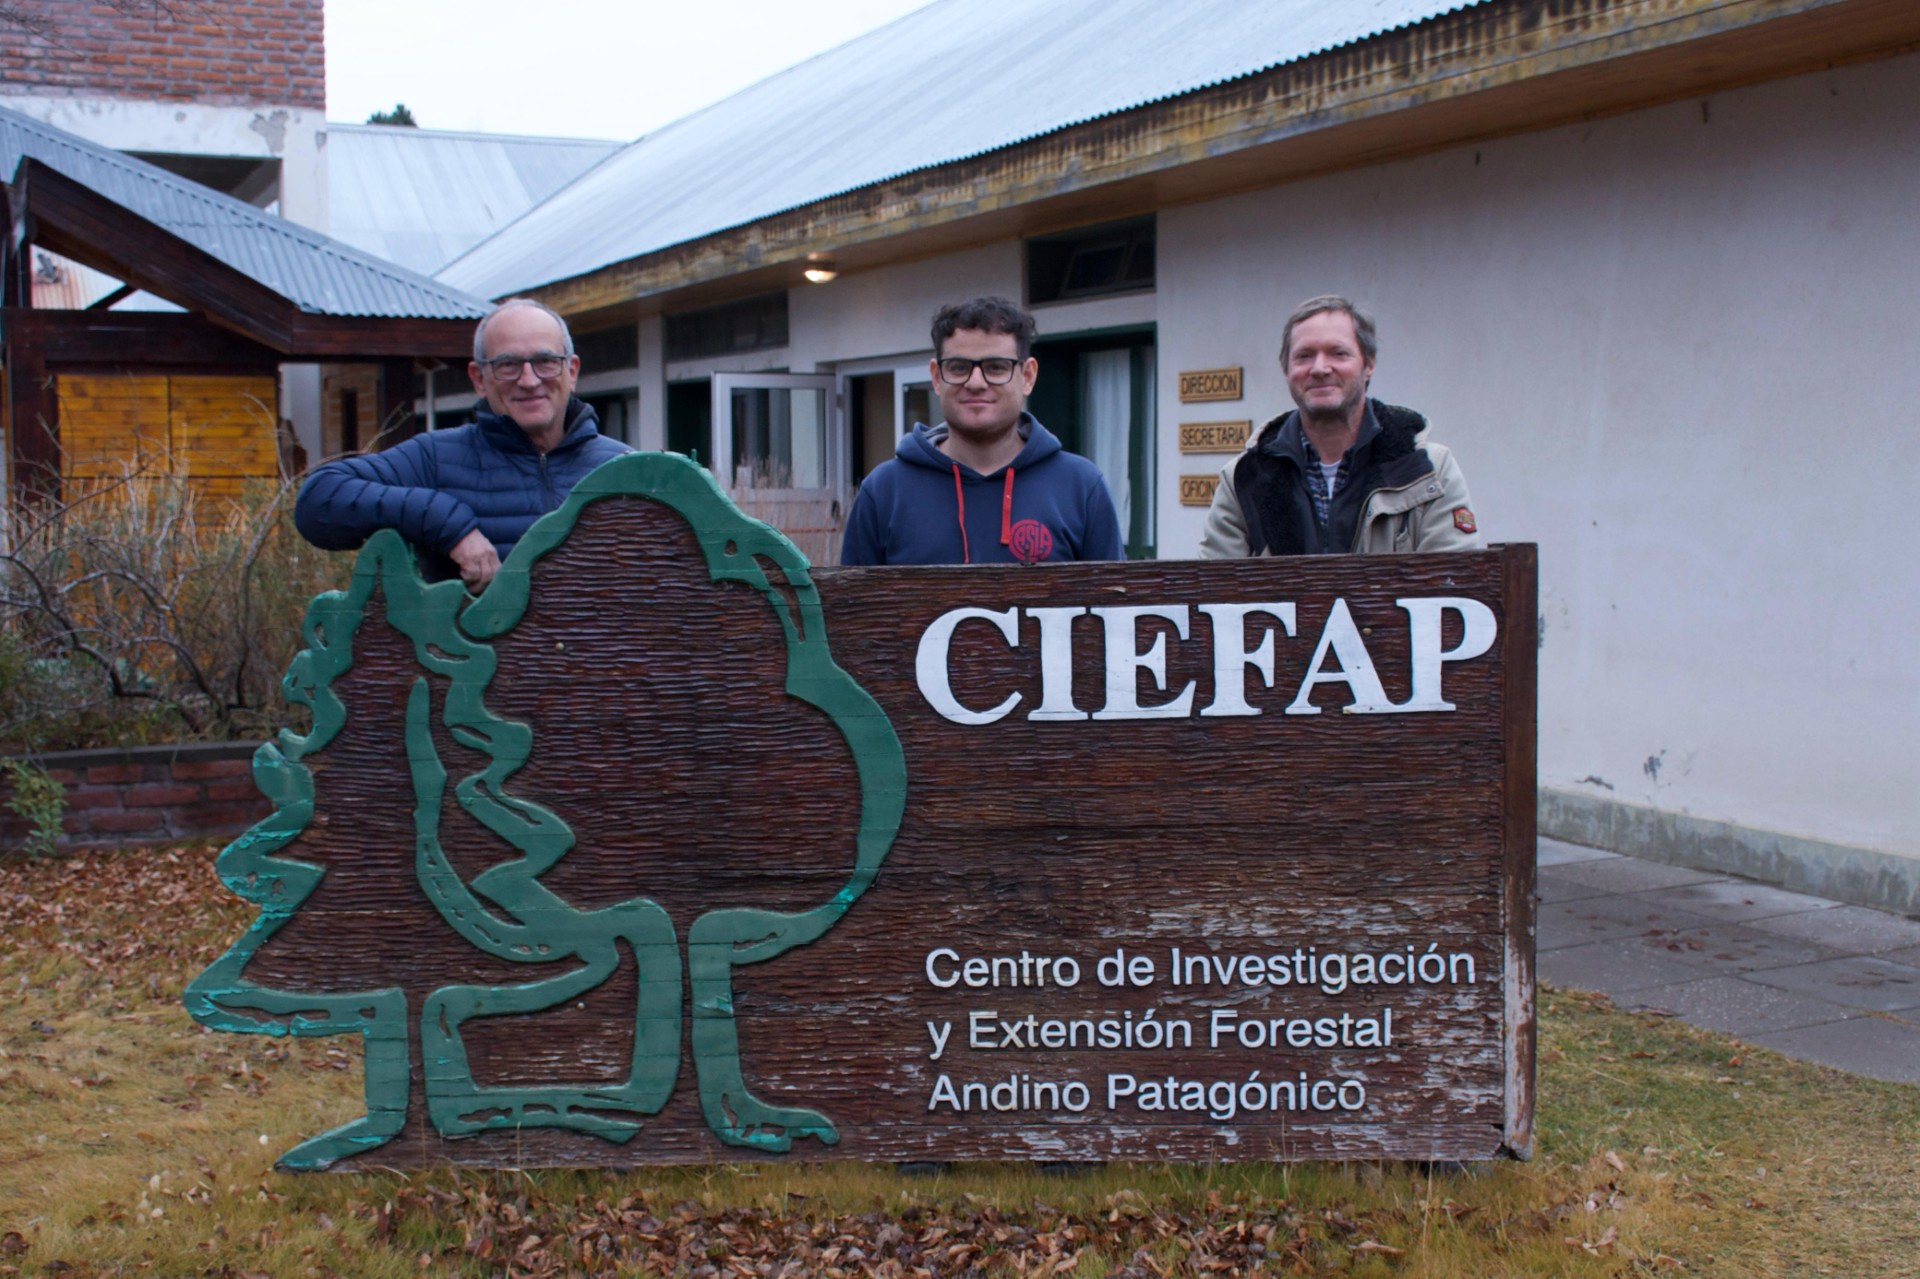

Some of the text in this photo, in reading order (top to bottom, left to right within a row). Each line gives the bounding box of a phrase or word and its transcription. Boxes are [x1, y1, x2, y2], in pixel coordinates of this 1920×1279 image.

[1181, 373, 1238, 395] DIRECCION
[1181, 426, 1246, 447] SECRETARIA
[1182, 479, 1219, 498] OFICIN
[915, 597, 1498, 725] CIEFAP
[925, 942, 1476, 995] Centro de Investigación
[926, 1007, 1394, 1060] y Extensión Forestal
[928, 1070, 1367, 1121] Andino Patagónico
